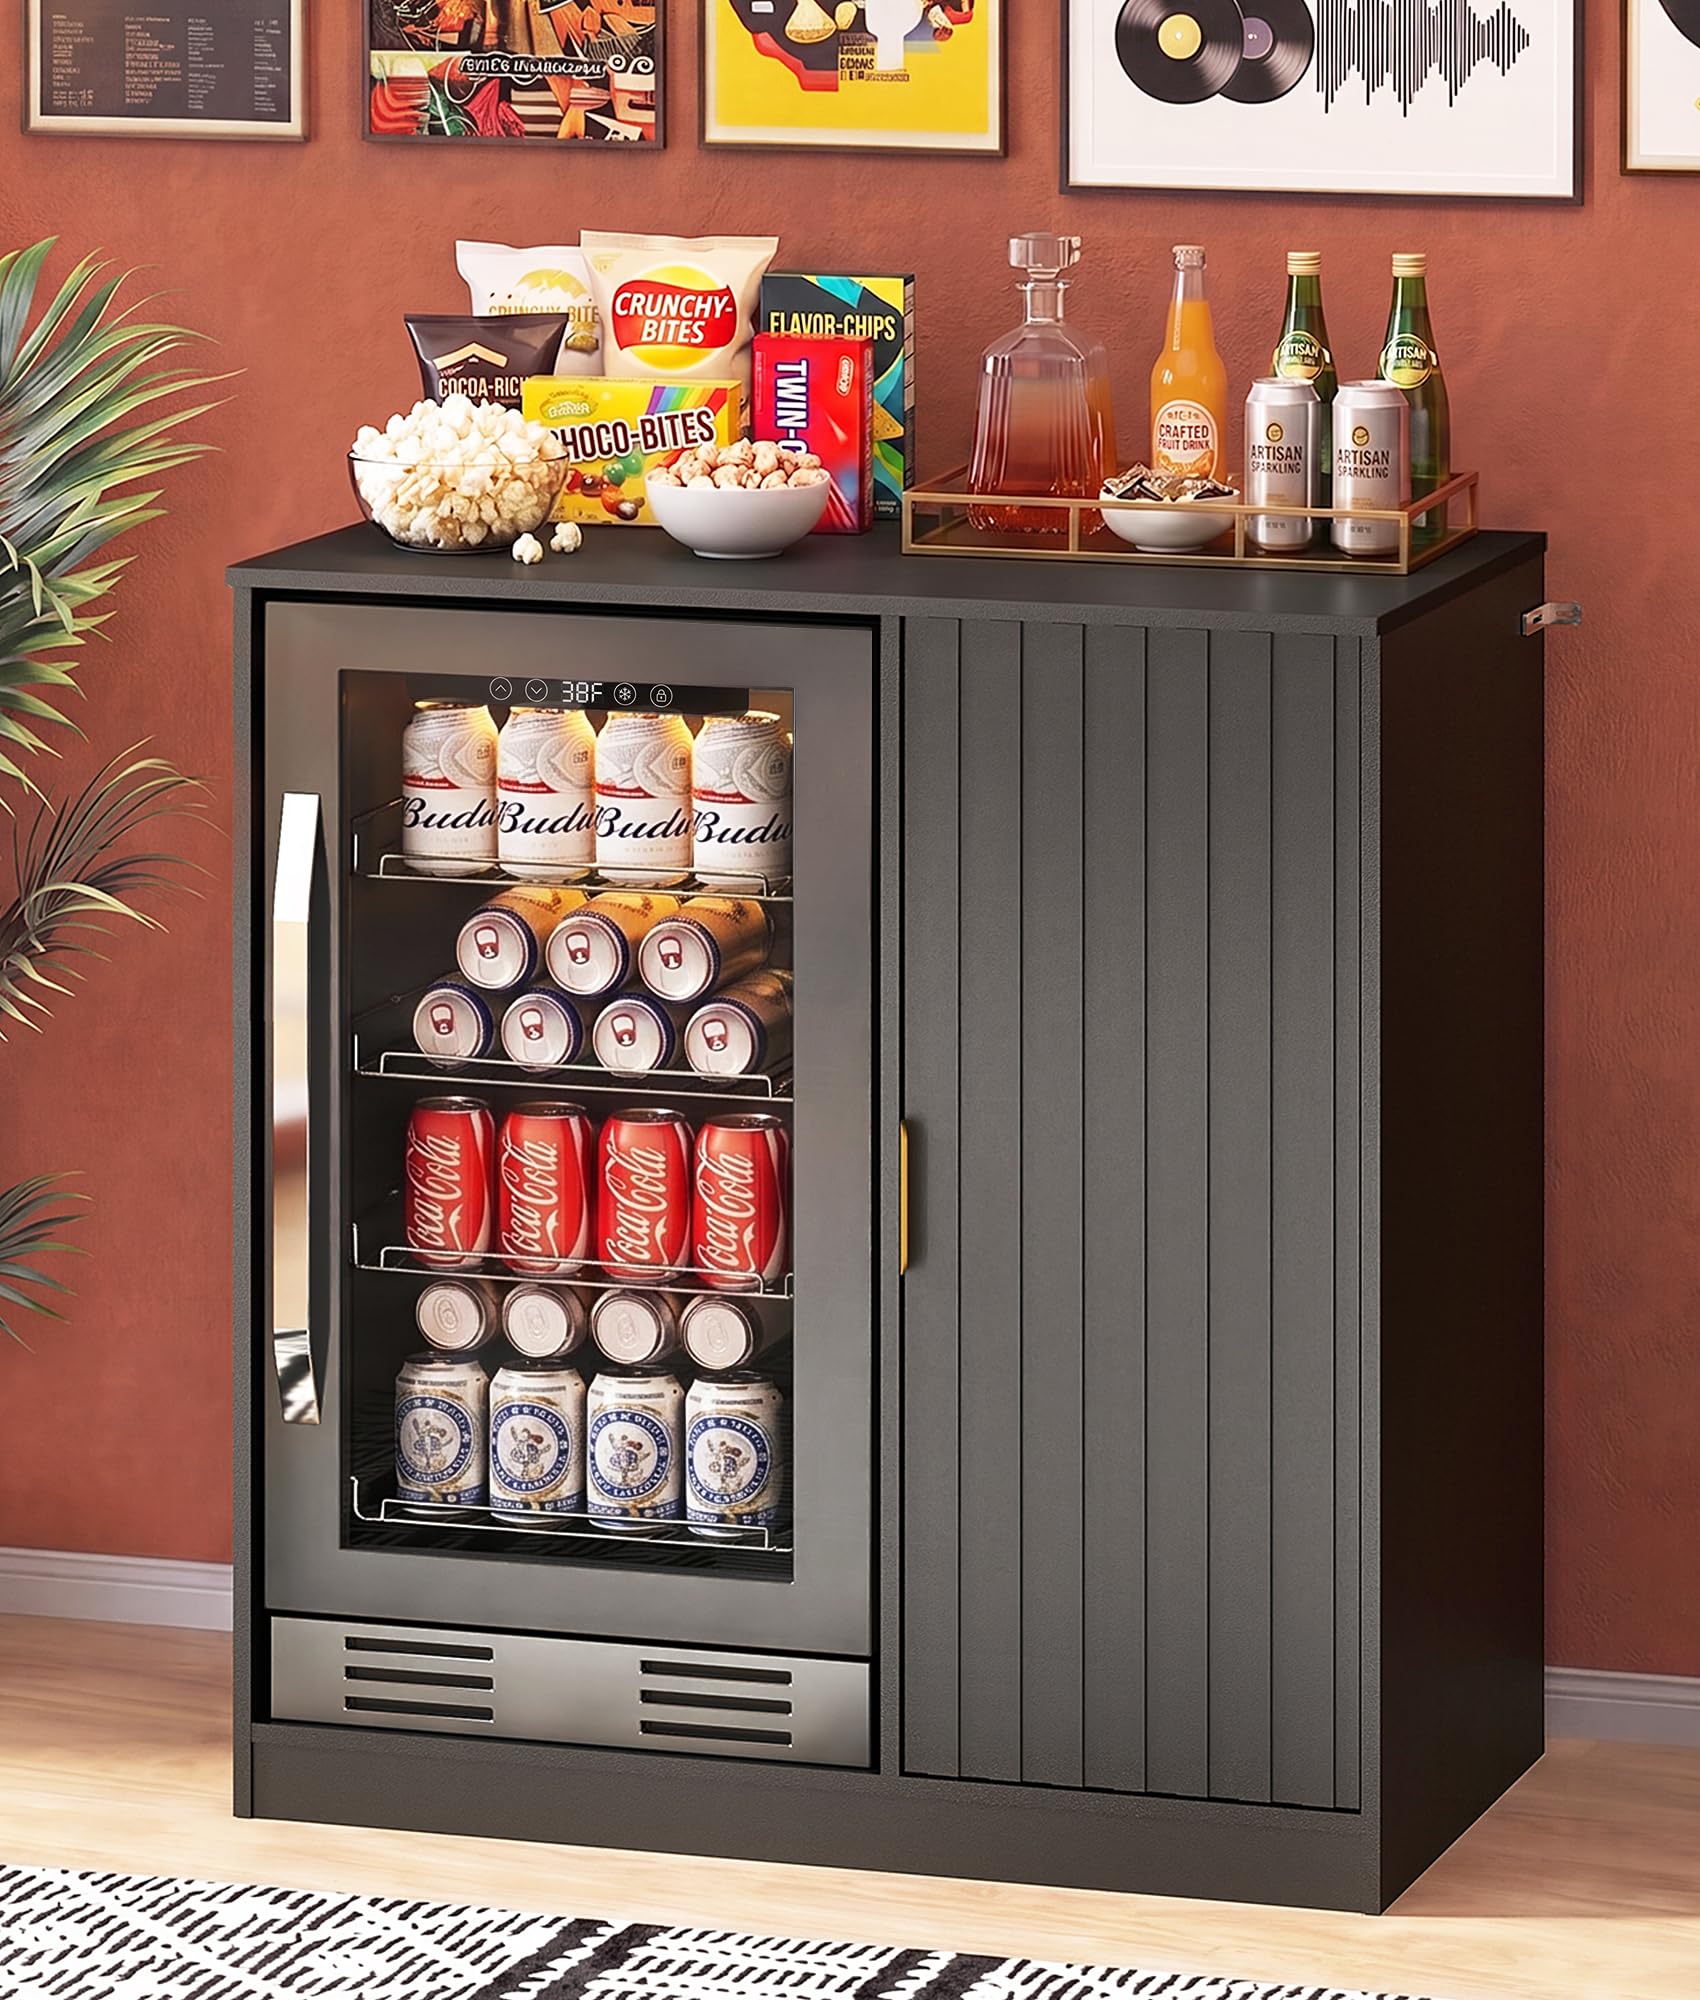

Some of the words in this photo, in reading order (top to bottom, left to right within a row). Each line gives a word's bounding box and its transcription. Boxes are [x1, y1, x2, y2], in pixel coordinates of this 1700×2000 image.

[614, 291, 734, 321] CRUNCHY-
[640, 318, 706, 344] BITES
[769, 311, 897, 341] FLAVOR-CHIPS
[551, 410, 715, 460] HOCO-BITES
[1159, 424, 1209, 439] CRAFTED
[1159, 438, 1180, 450] FRUIT
[1183, 440, 1210, 451] DRINK
[1250, 445, 1303, 462] ARTISAN
[1337, 449, 1390, 466] ARTISAN
[1251, 461, 1302, 474] SPARKLING
[1338, 466, 1389, 479] SPARKLING
[562, 681, 603, 703] 38F
